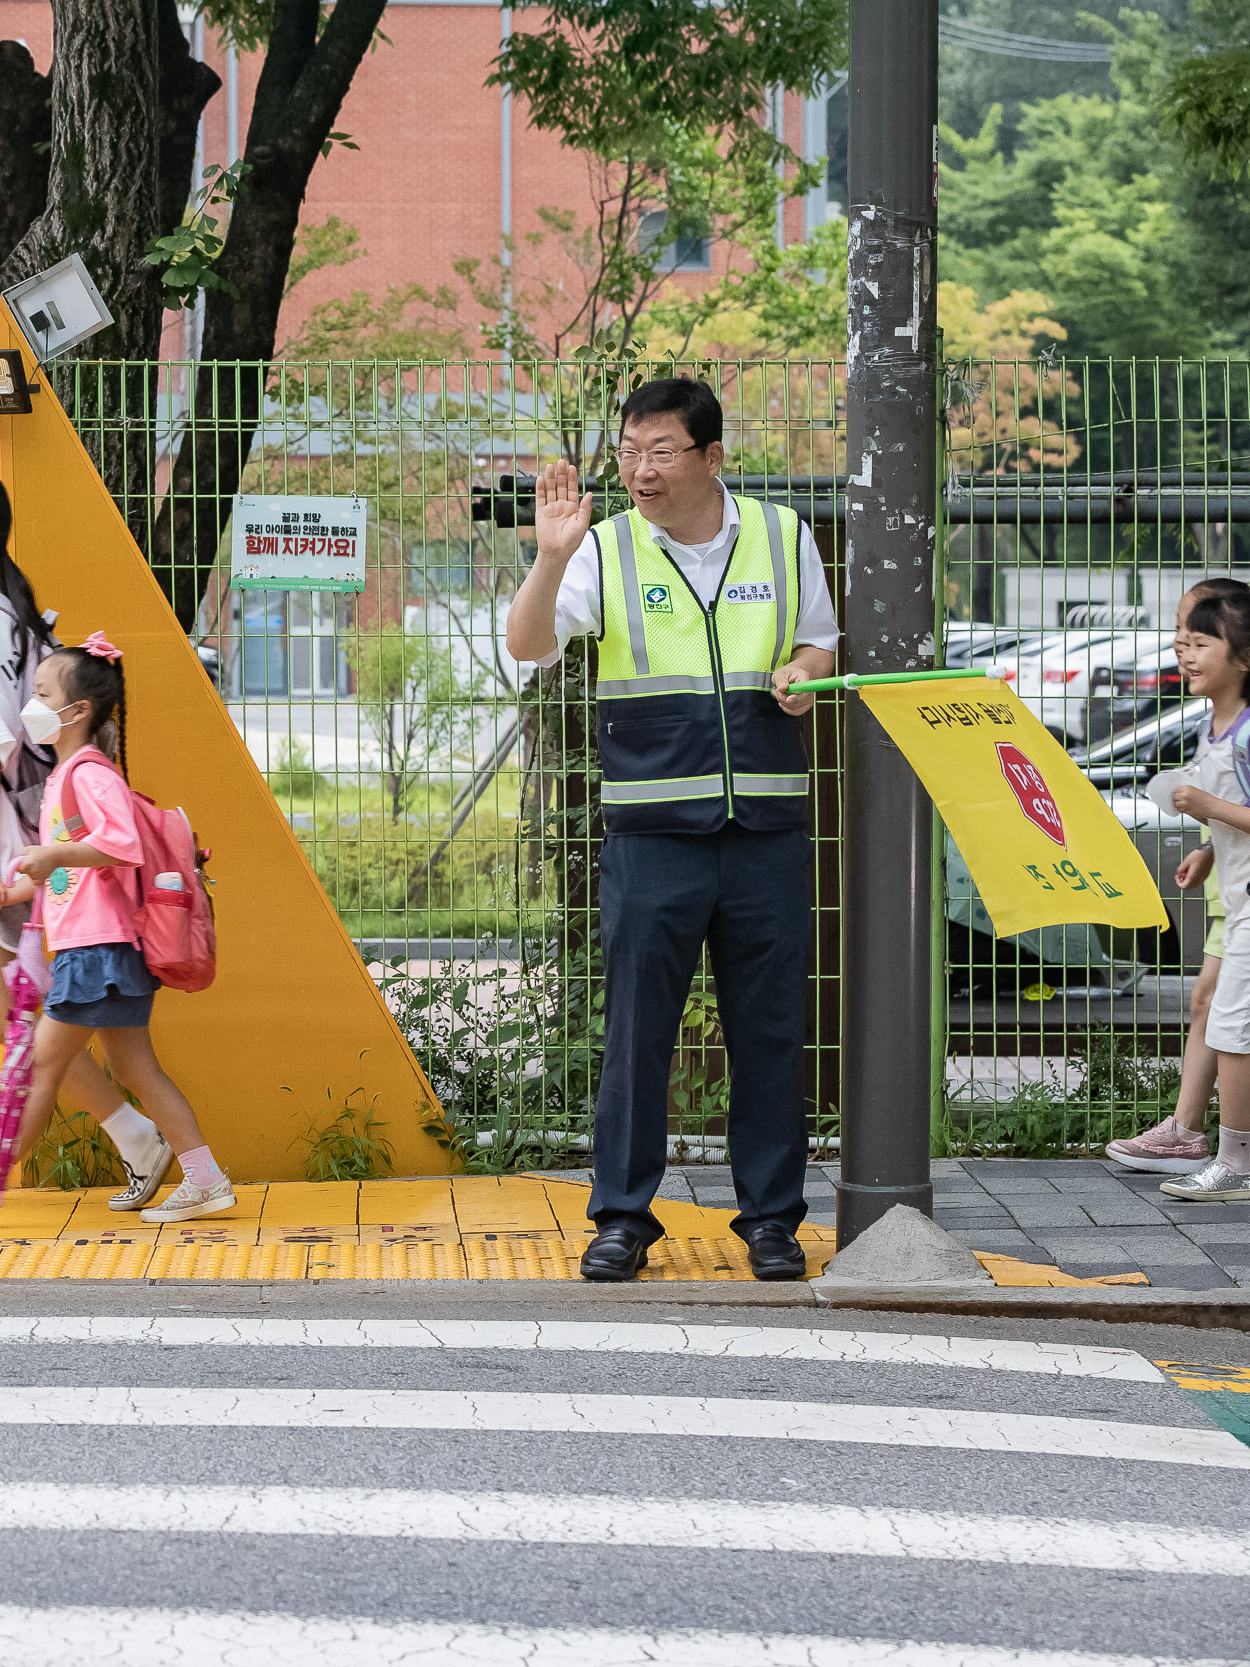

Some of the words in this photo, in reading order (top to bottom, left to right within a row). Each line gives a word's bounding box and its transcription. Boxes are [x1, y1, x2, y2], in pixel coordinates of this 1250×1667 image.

[303, 512, 321, 523] 희망
[245, 523, 263, 535] 우리
[265, 524, 301, 536] 아이들의
[302, 525, 329, 537] 안전한
[245, 535, 278, 555] 함께
[282, 536, 356, 558] 지켜가요!
